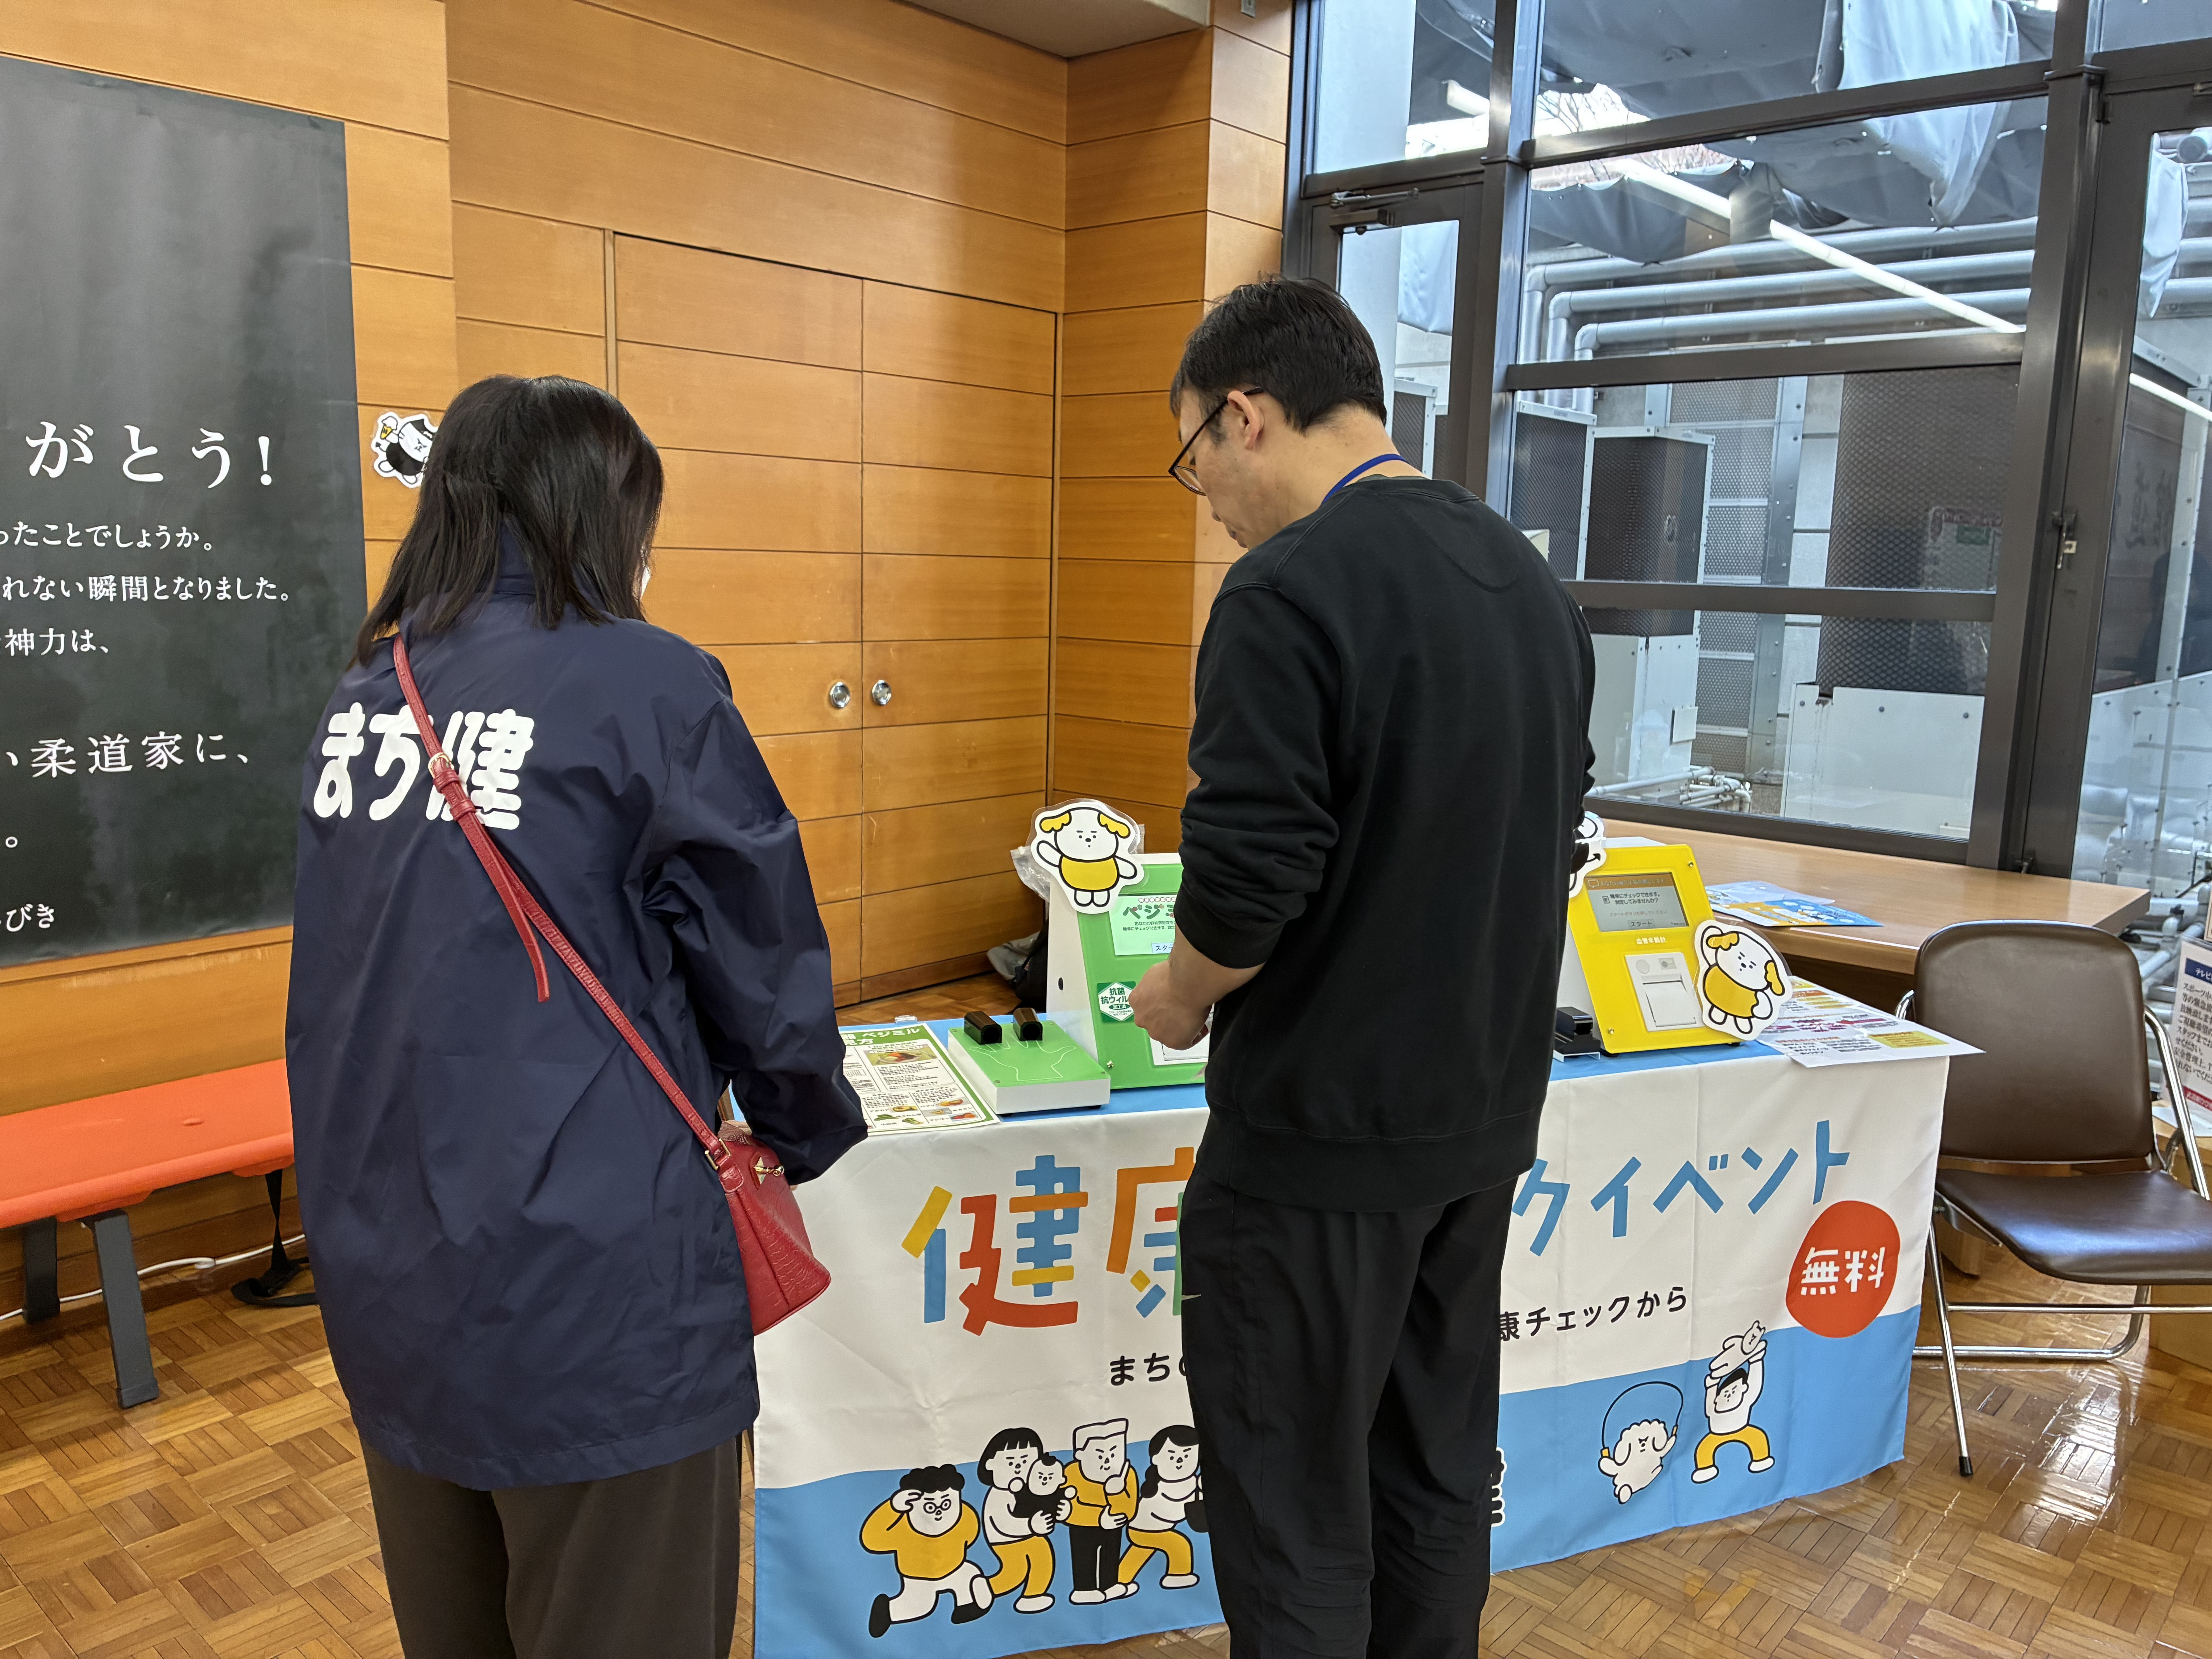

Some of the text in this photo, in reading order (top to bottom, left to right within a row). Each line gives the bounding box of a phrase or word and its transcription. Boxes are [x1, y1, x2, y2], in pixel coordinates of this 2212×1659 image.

[2, 575, 289, 602] れない瞬間となりました。
[313, 702, 535, 830] まち健
[1109, 987, 1125, 996] 抗菌
[862, 1028, 920, 1037] ベジミル
[1512, 1120, 1850, 1256] クイベント
[1801, 1246, 1885, 1295] 無料
[1500, 1286, 1687, 1341] 康チェックから
